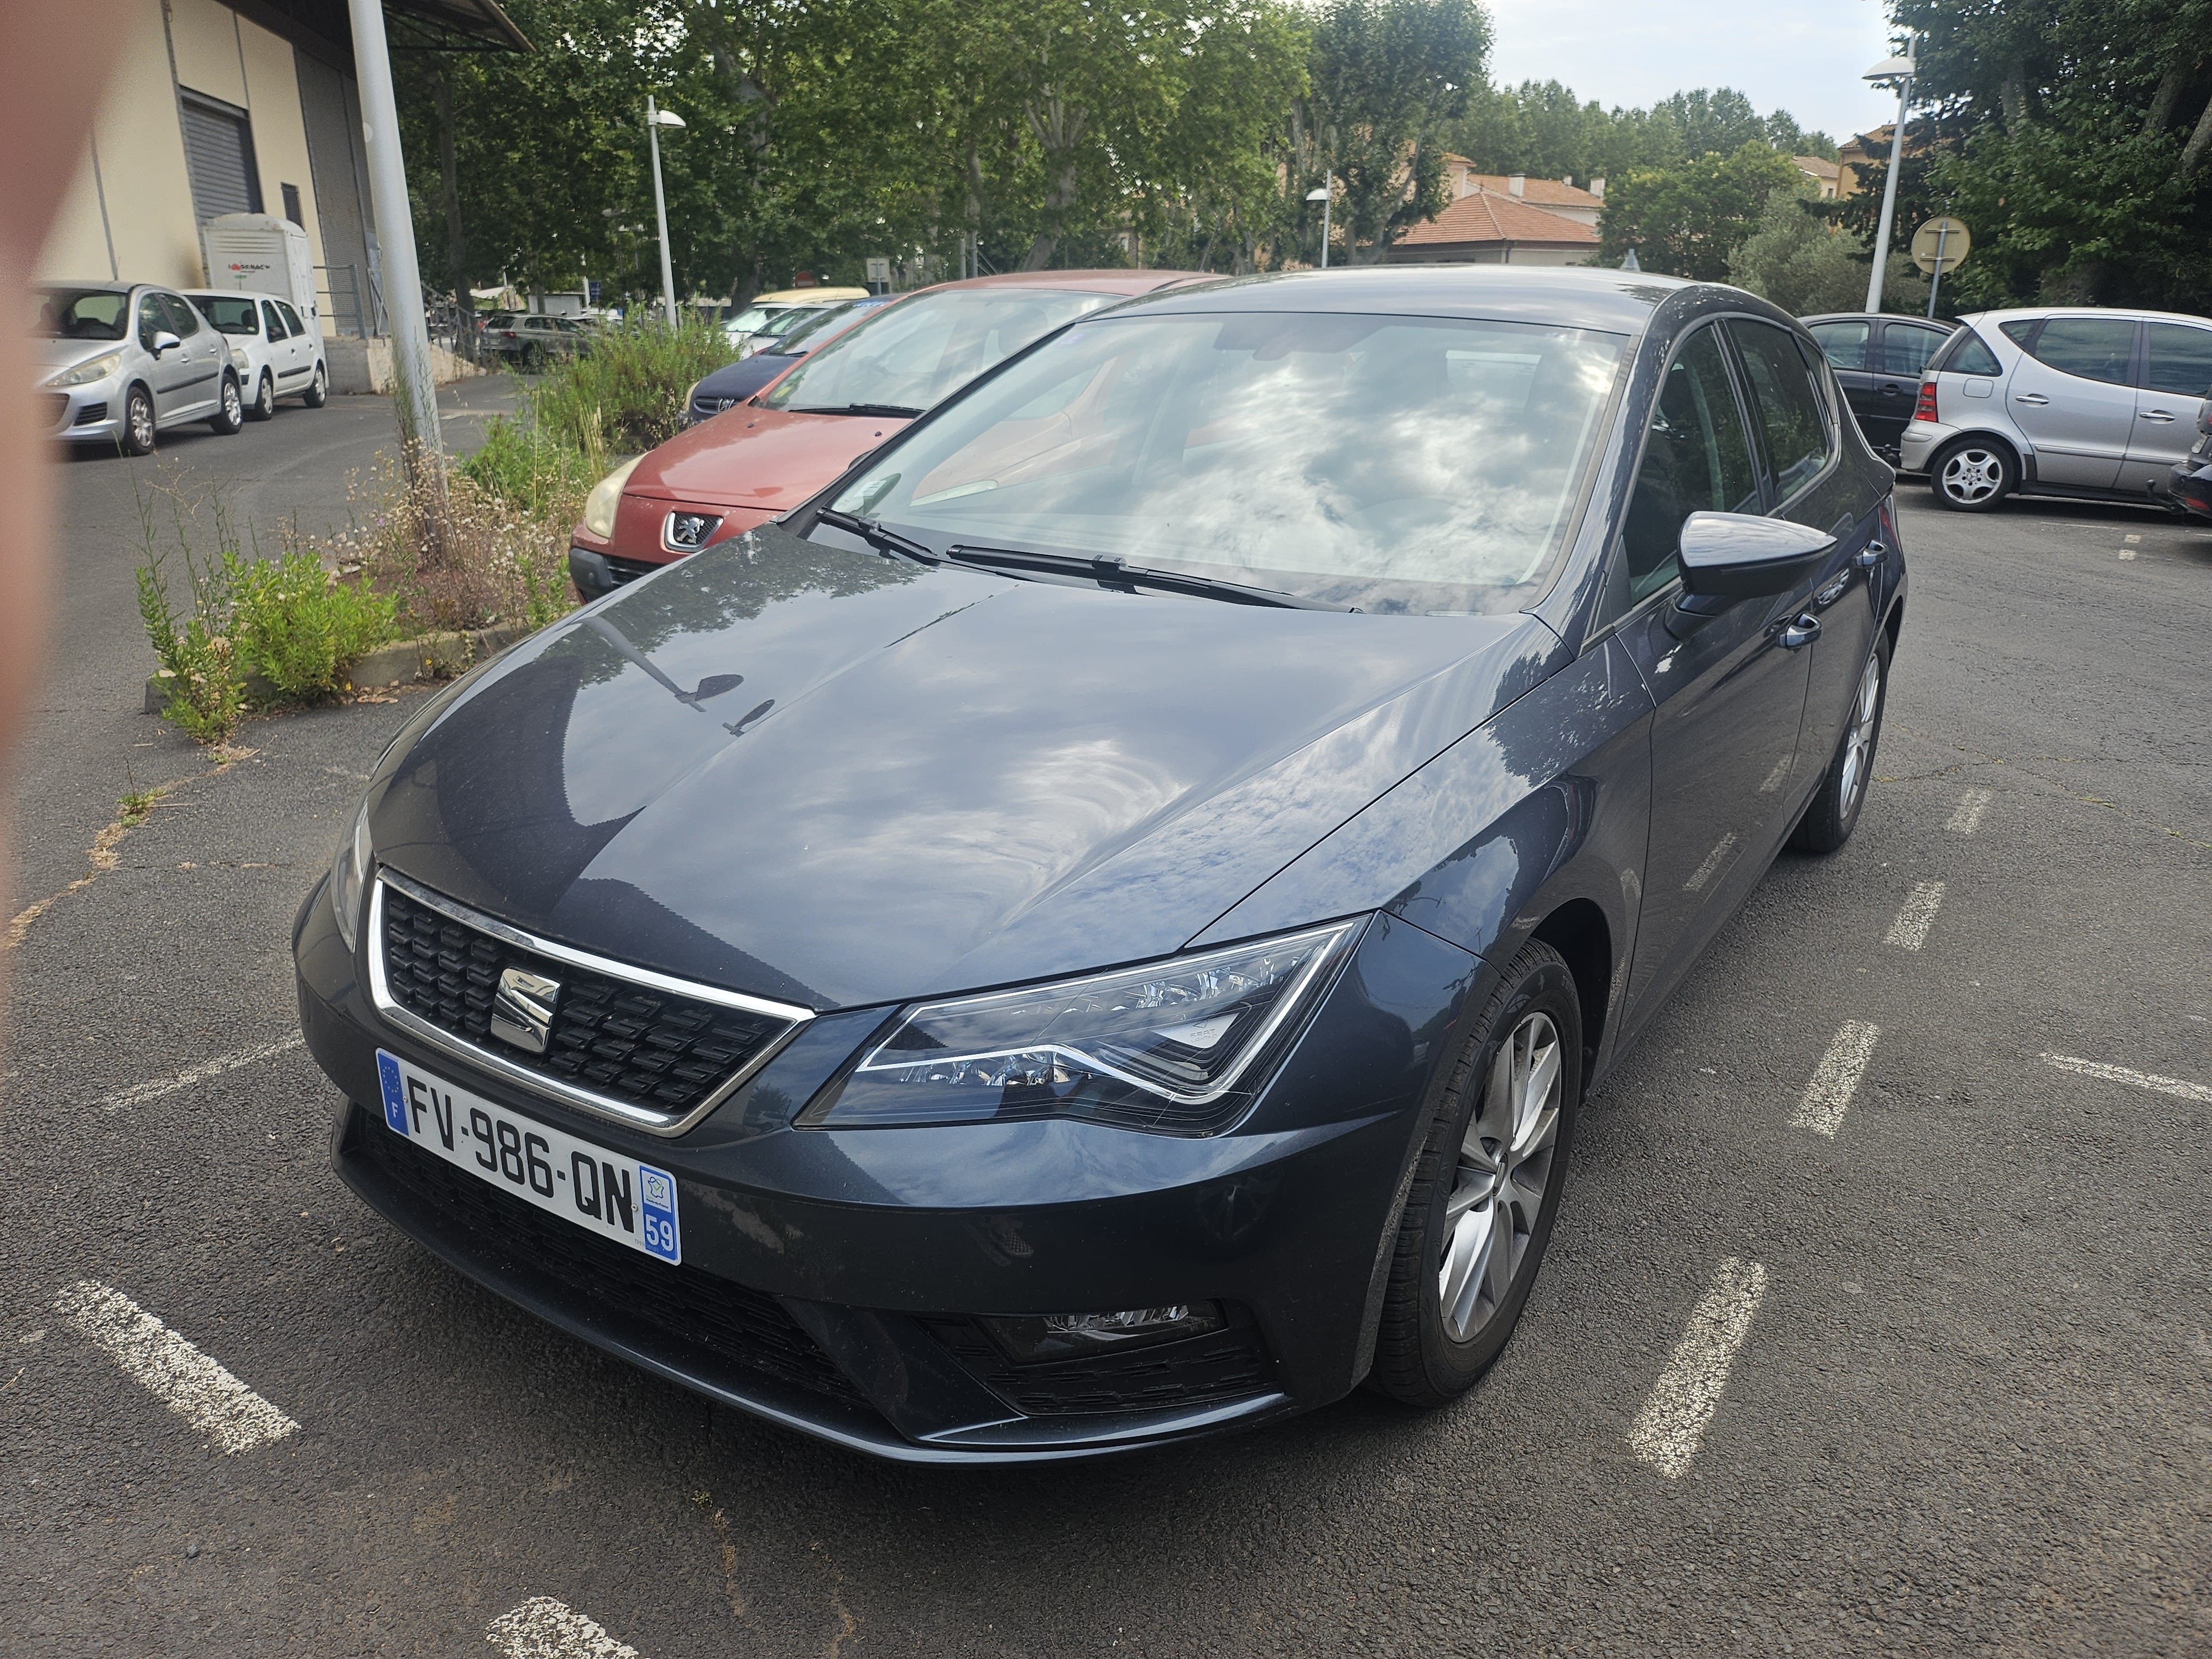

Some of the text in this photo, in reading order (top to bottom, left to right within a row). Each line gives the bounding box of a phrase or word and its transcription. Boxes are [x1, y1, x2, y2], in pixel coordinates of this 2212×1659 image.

[1190, 1029, 1216, 1039] SEAT
[392, 1101, 399, 1118] F
[406, 1075, 635, 1233] FV-986-QN
[645, 1213, 674, 1252] 59
